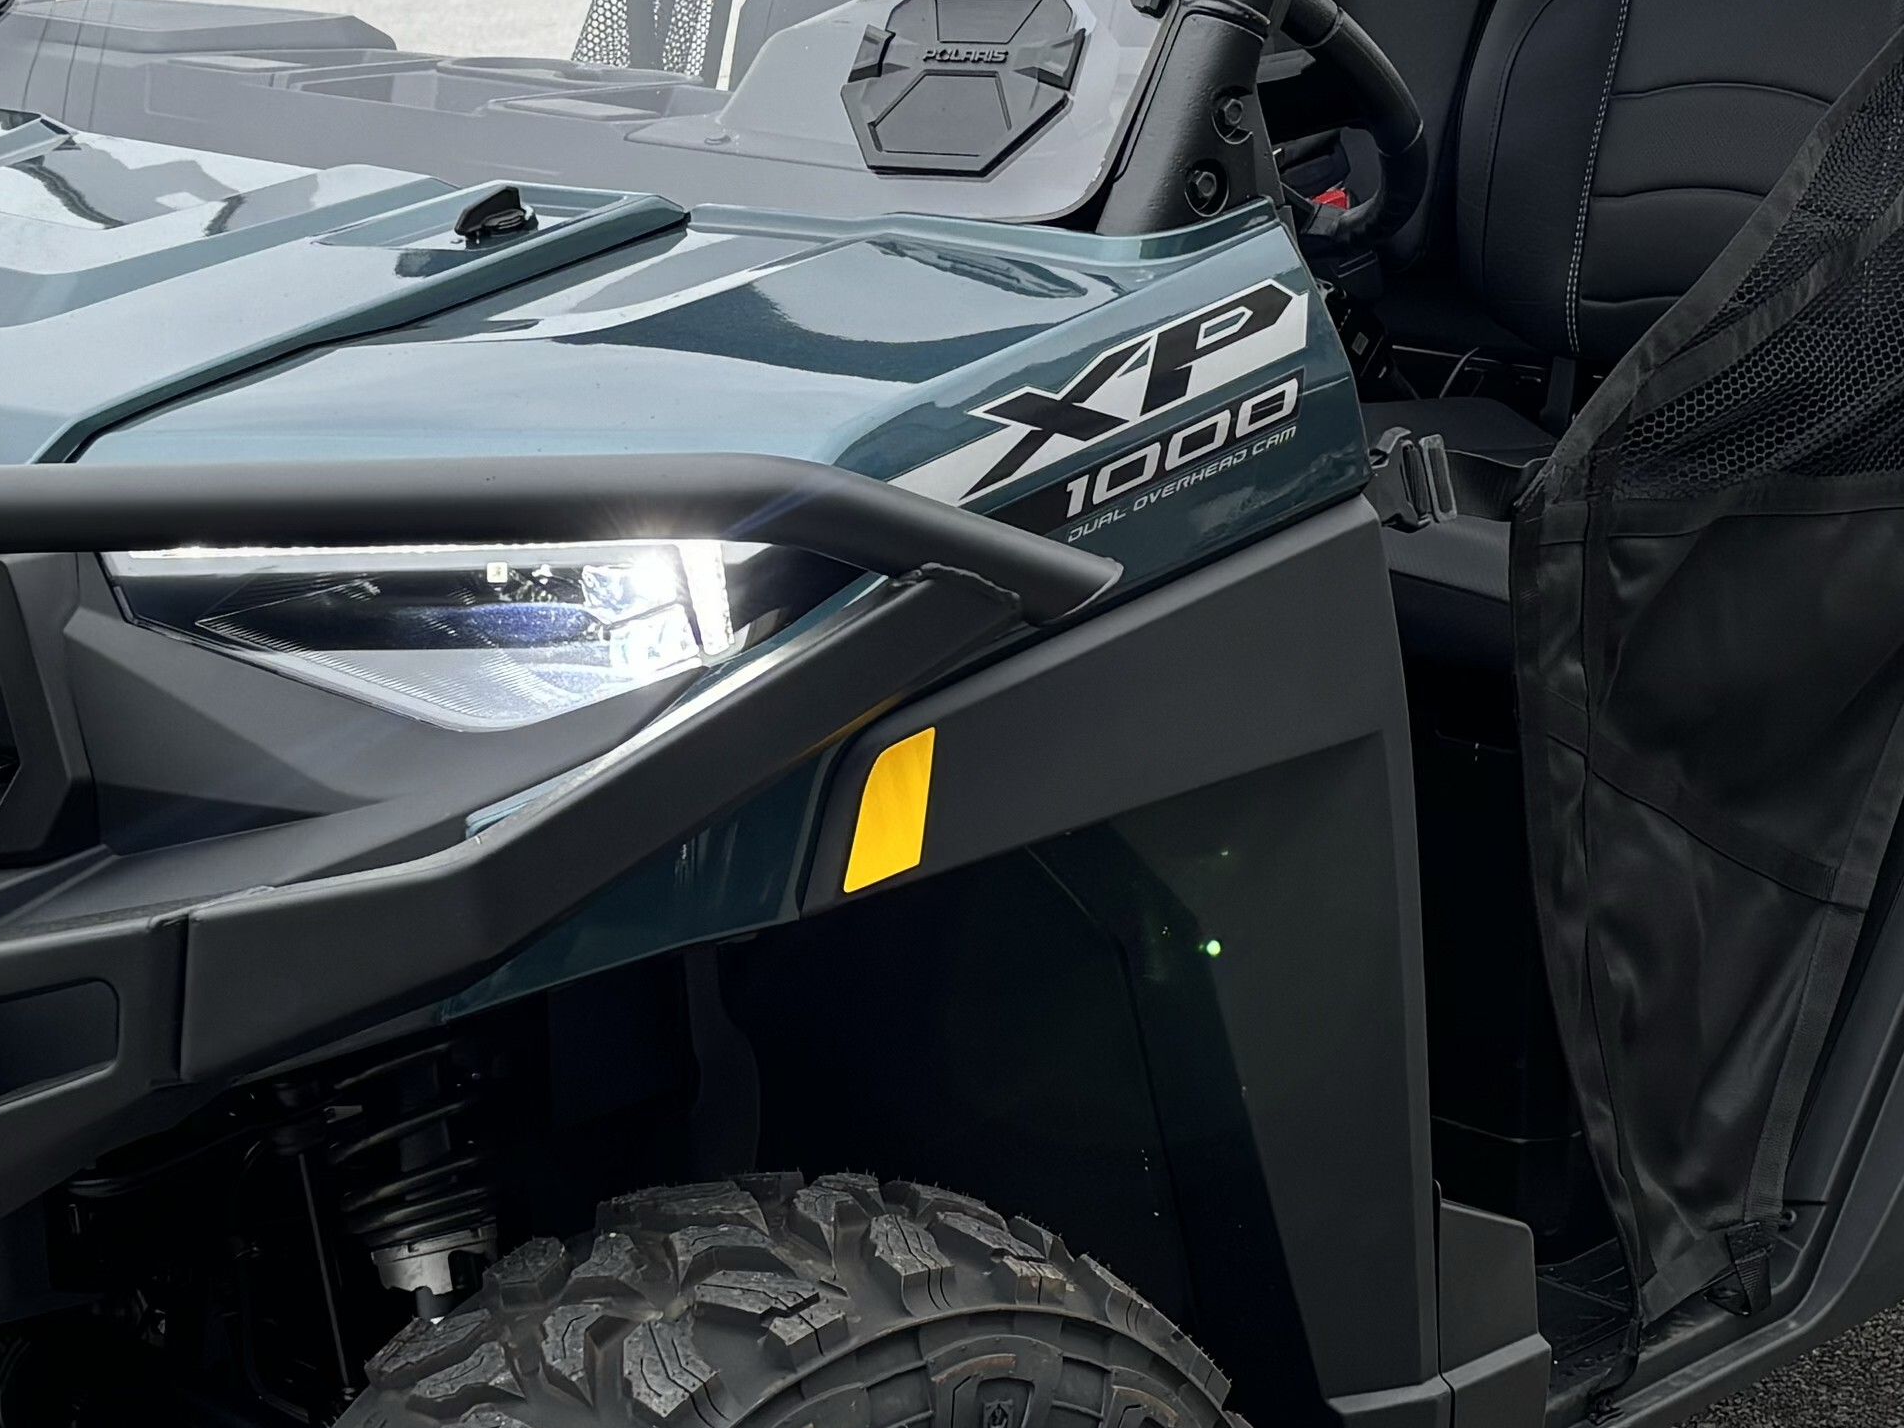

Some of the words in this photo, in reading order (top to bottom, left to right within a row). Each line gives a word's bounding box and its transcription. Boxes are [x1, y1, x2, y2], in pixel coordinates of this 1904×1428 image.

[922, 48, 1009, 65] POLARIS
[958, 283, 1294, 501] XP
[1064, 377, 1300, 519] 1000
[1067, 508, 1127, 544] DUAL
[1132, 448, 1248, 512] OVERHEAD
[1252, 425, 1297, 457] CAM
